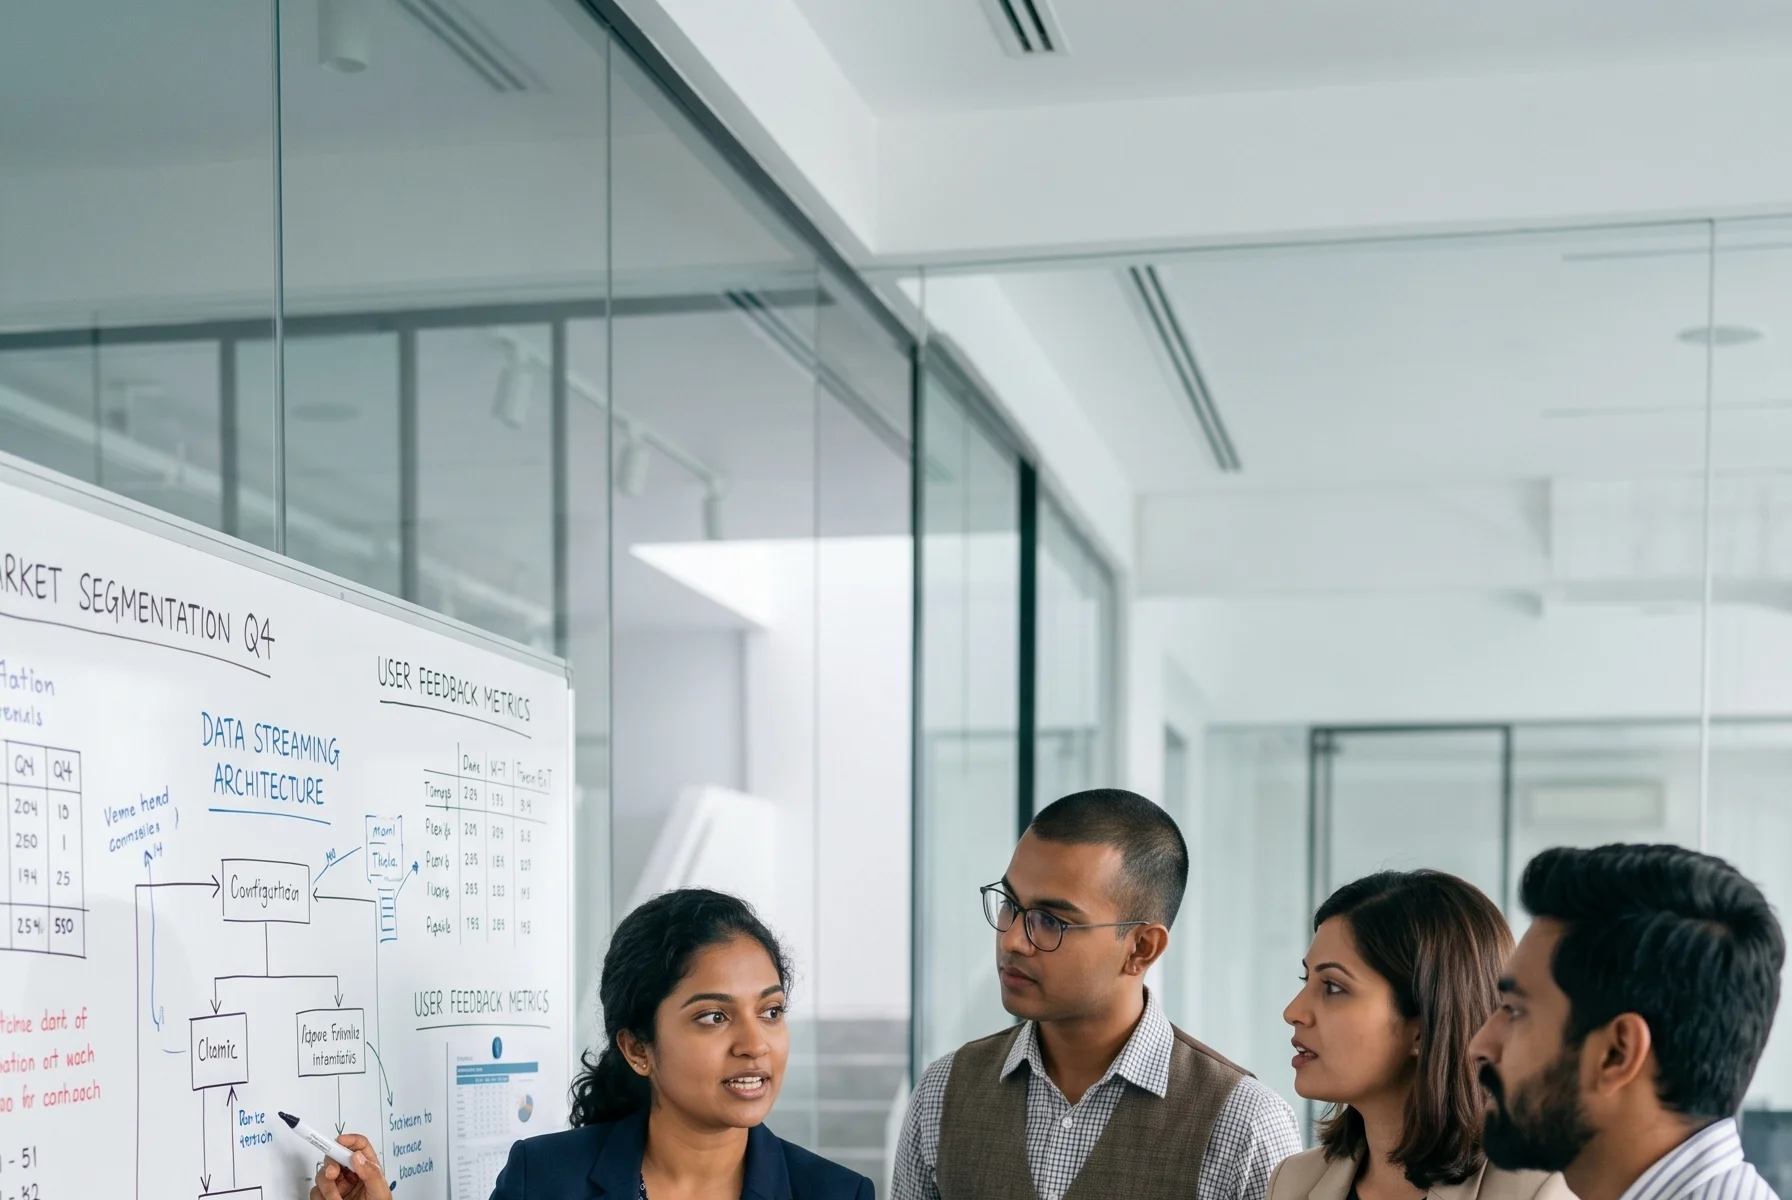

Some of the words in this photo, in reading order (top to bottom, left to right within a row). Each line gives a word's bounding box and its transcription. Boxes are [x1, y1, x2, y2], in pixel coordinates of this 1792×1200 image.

[0, 553, 62, 603] RKET
[79, 572, 231, 643] SEGMENTATION
[244, 612, 275, 660] Q4
[377, 655, 413, 690] USER
[419, 666, 478, 707] FEEDBACK
[484, 687, 532, 722] METRICS
[202, 711, 246, 751] DATA
[254, 722, 340, 771] STREAMING
[53, 760, 73, 782] Q4
[213, 762, 325, 806] ARCHITECTURE
[56, 870, 70, 886] 25
[414, 990, 443, 1017] USER
[450, 990, 503, 1014] FEEDBACK
[508, 989, 549, 1014] METRICS
[75, 1005, 88, 1030] of
[21, 1145, 37, 1169] 51
